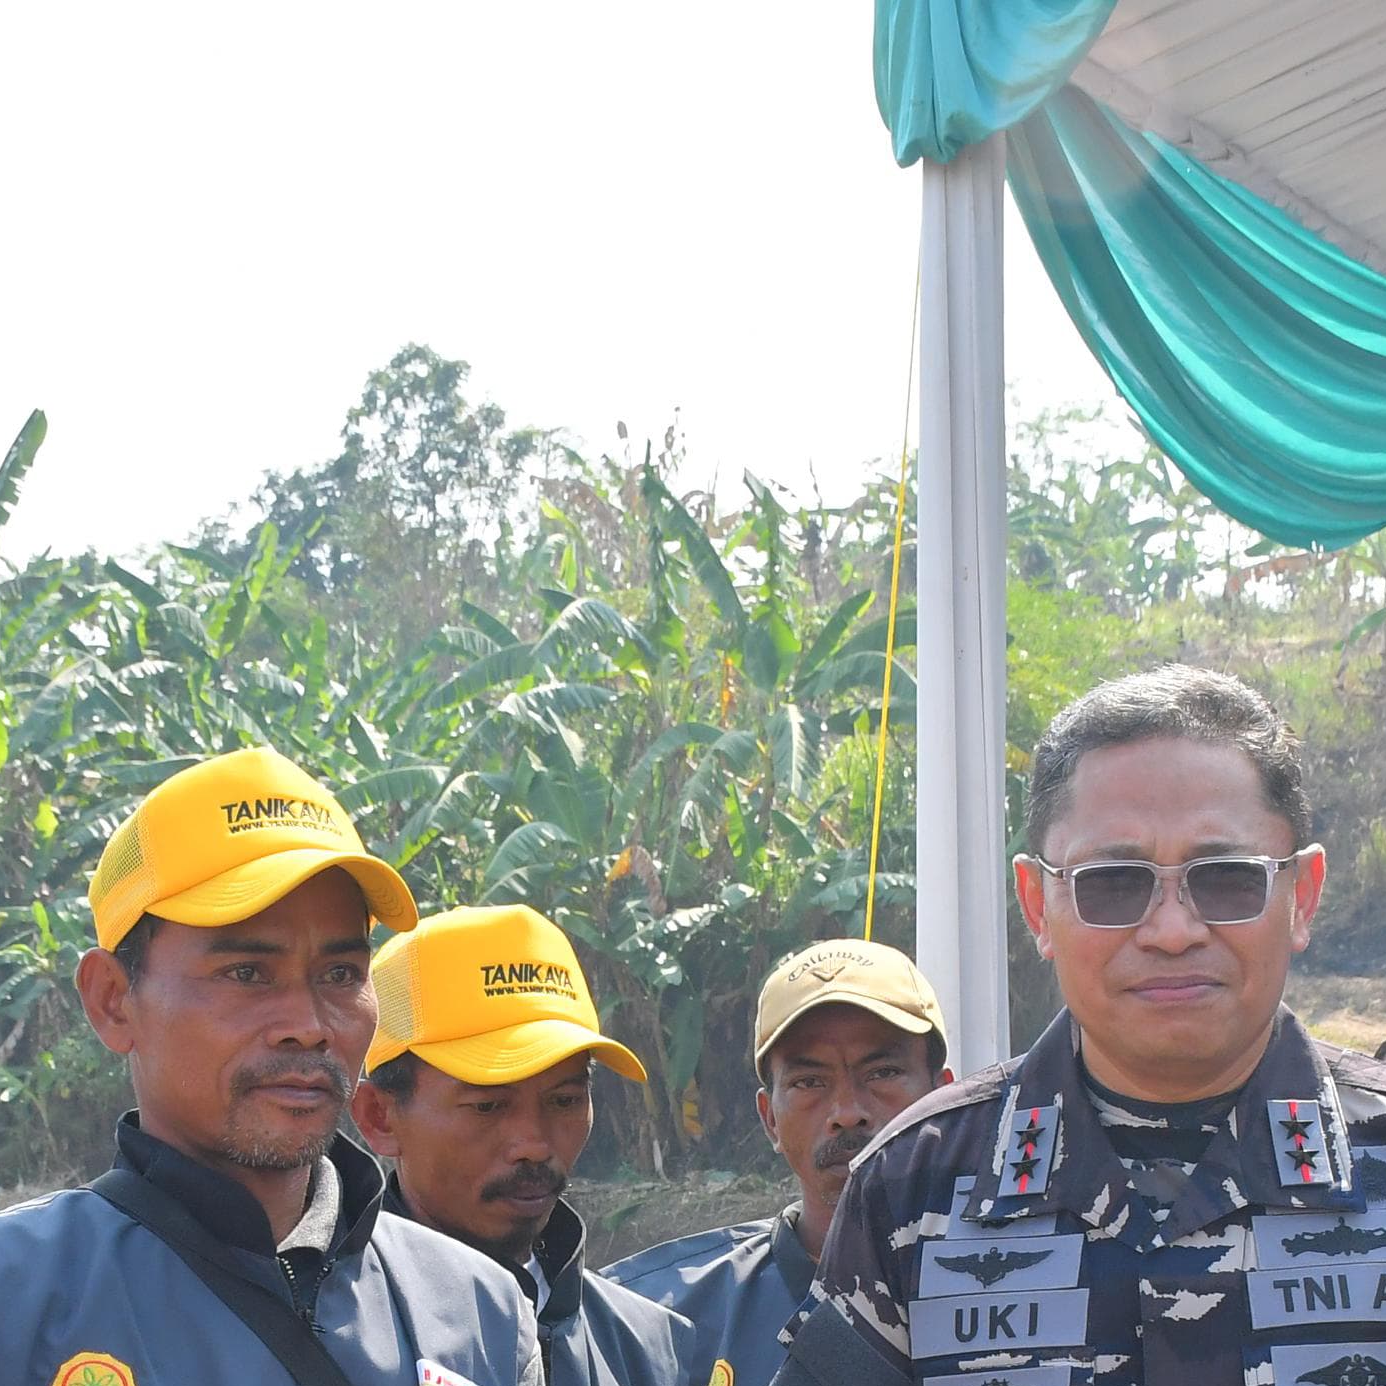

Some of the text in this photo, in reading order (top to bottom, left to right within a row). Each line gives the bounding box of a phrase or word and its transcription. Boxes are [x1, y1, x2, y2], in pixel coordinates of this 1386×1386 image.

[221, 798, 336, 825] TANIKAYA
[480, 963, 573, 989] TANIKAYA
[1273, 1273, 1351, 1313] TNI
[954, 1302, 1039, 1343] UKI
